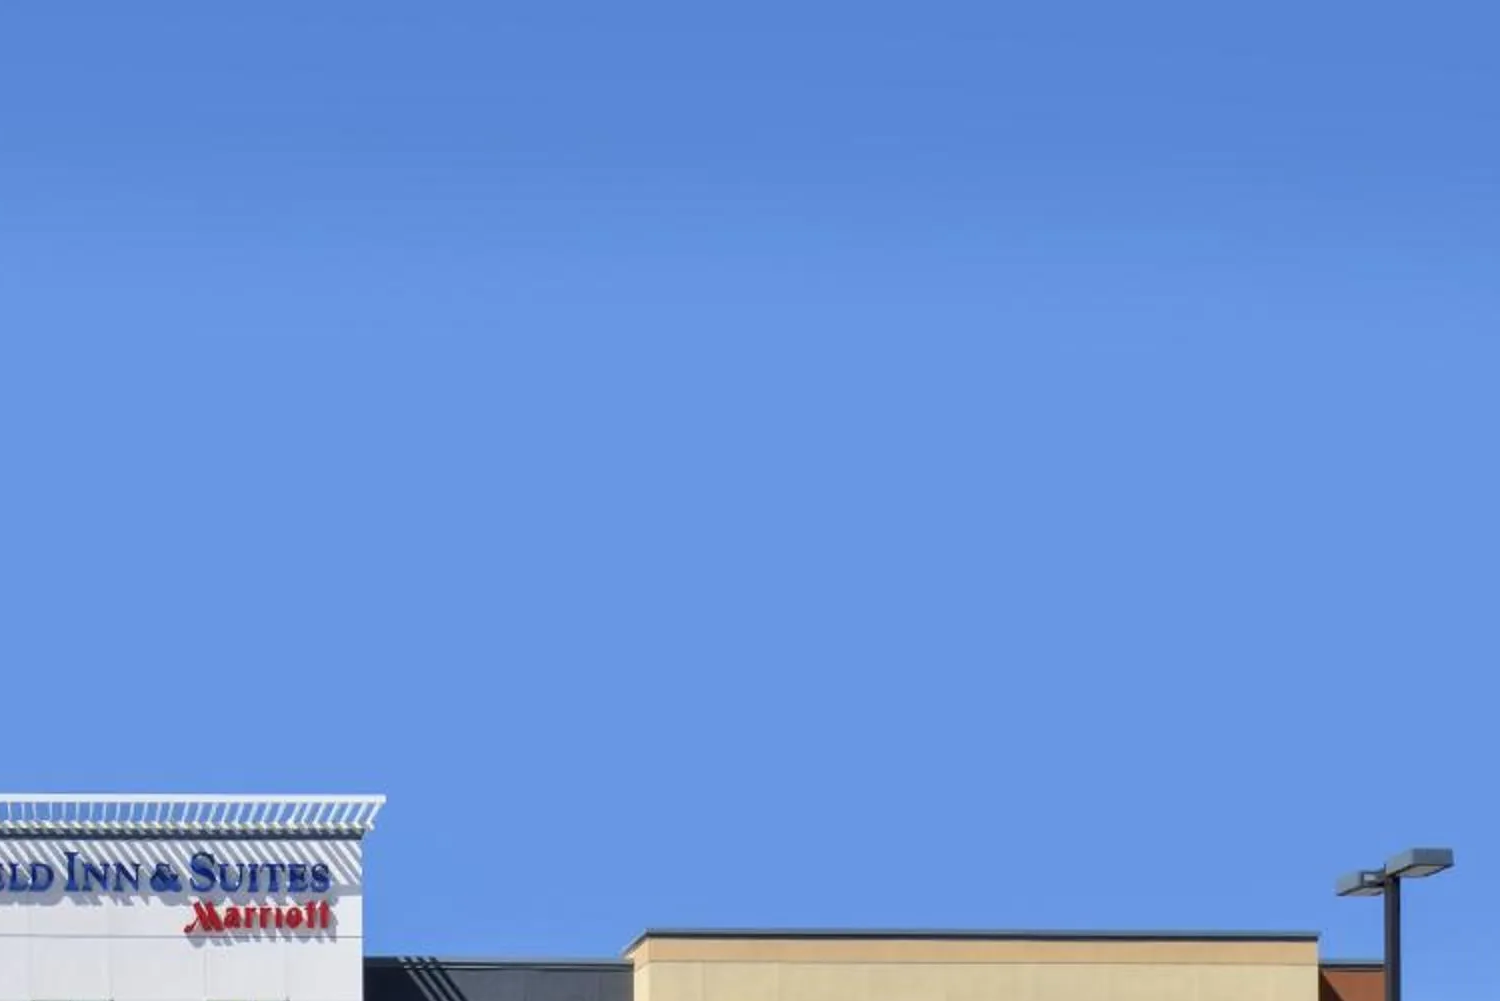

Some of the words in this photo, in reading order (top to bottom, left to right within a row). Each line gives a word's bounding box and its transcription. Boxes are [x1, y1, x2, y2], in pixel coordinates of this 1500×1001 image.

[64, 851, 141, 893] INN
[151, 862, 182, 893] &
[190, 851, 332, 893] SUITES
[184, 900, 332, 933] Marriott
